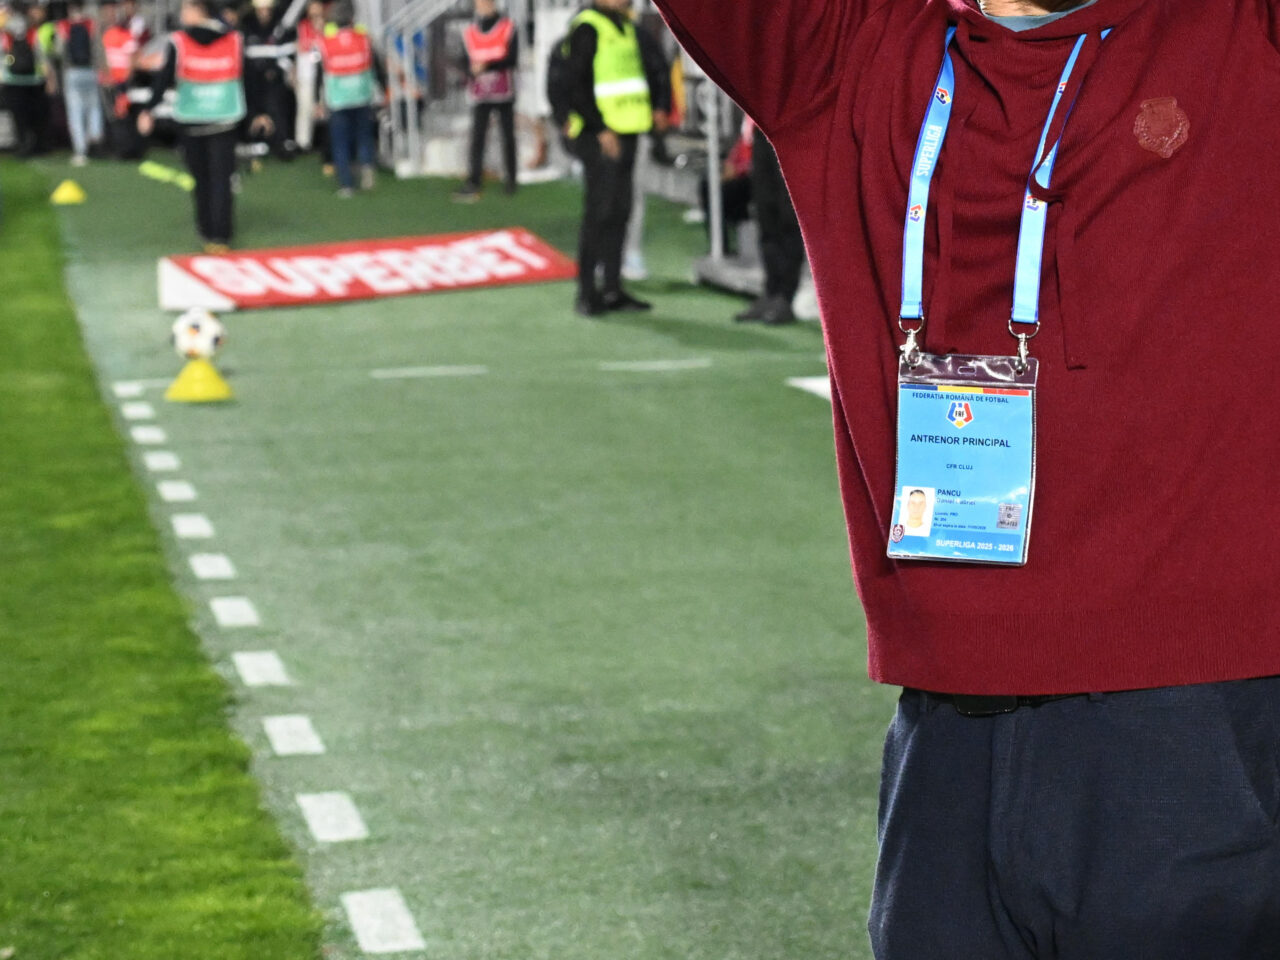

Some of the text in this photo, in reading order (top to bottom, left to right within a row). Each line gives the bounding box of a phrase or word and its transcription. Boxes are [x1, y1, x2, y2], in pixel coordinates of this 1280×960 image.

[916, 124, 943, 176] SUPERLIGA
[190, 230, 549, 297] SUPERBET
[985, 396, 1009, 404] FOTBAL
[910, 434, 1011, 448] ANTRENOR PRINCIPAL
[937, 489, 961, 497] PANCU
[935, 539, 976, 549] SUPERLIGA
[977, 542, 993, 550] 2025
